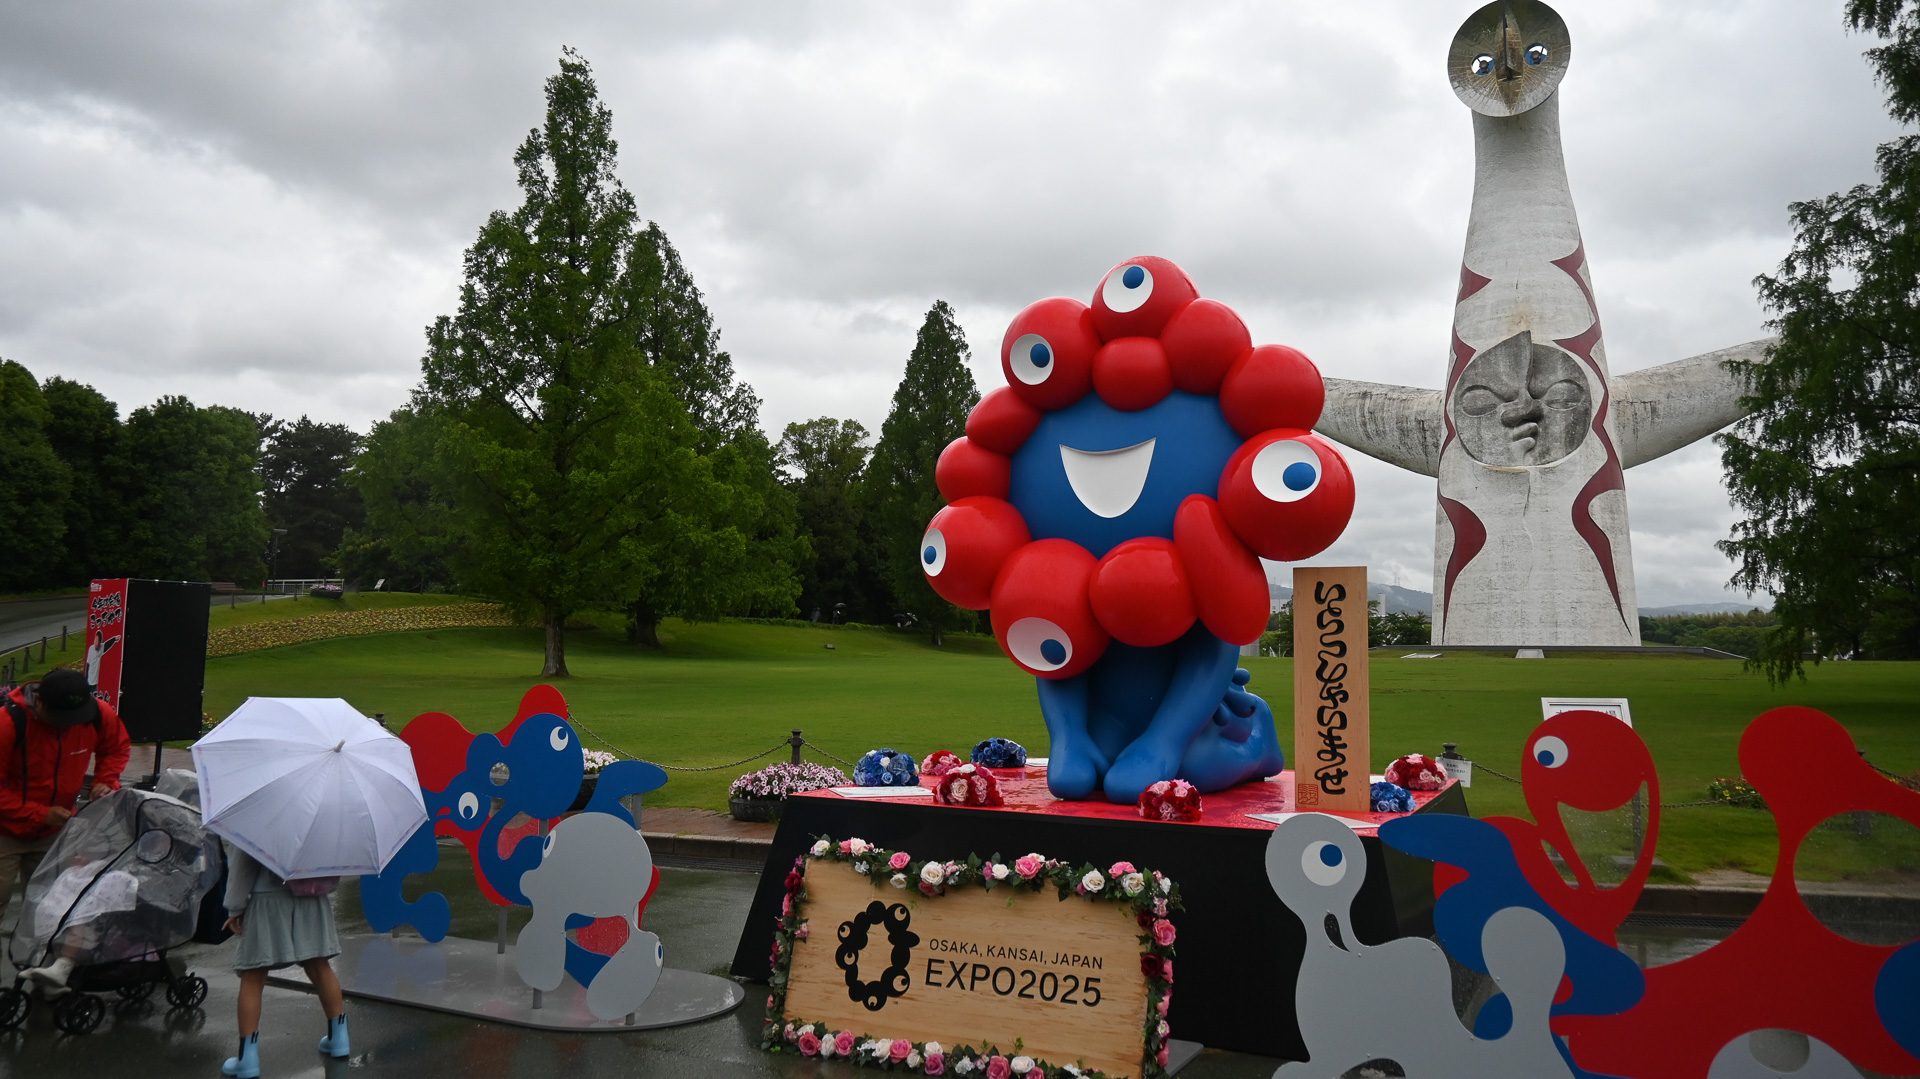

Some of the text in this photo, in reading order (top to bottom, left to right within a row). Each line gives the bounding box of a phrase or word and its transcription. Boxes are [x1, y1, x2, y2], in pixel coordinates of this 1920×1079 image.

[929, 938, 1103, 970] OSAKA, KANSAI, JAPAN
[924, 957, 1102, 1008] EXPO2025
